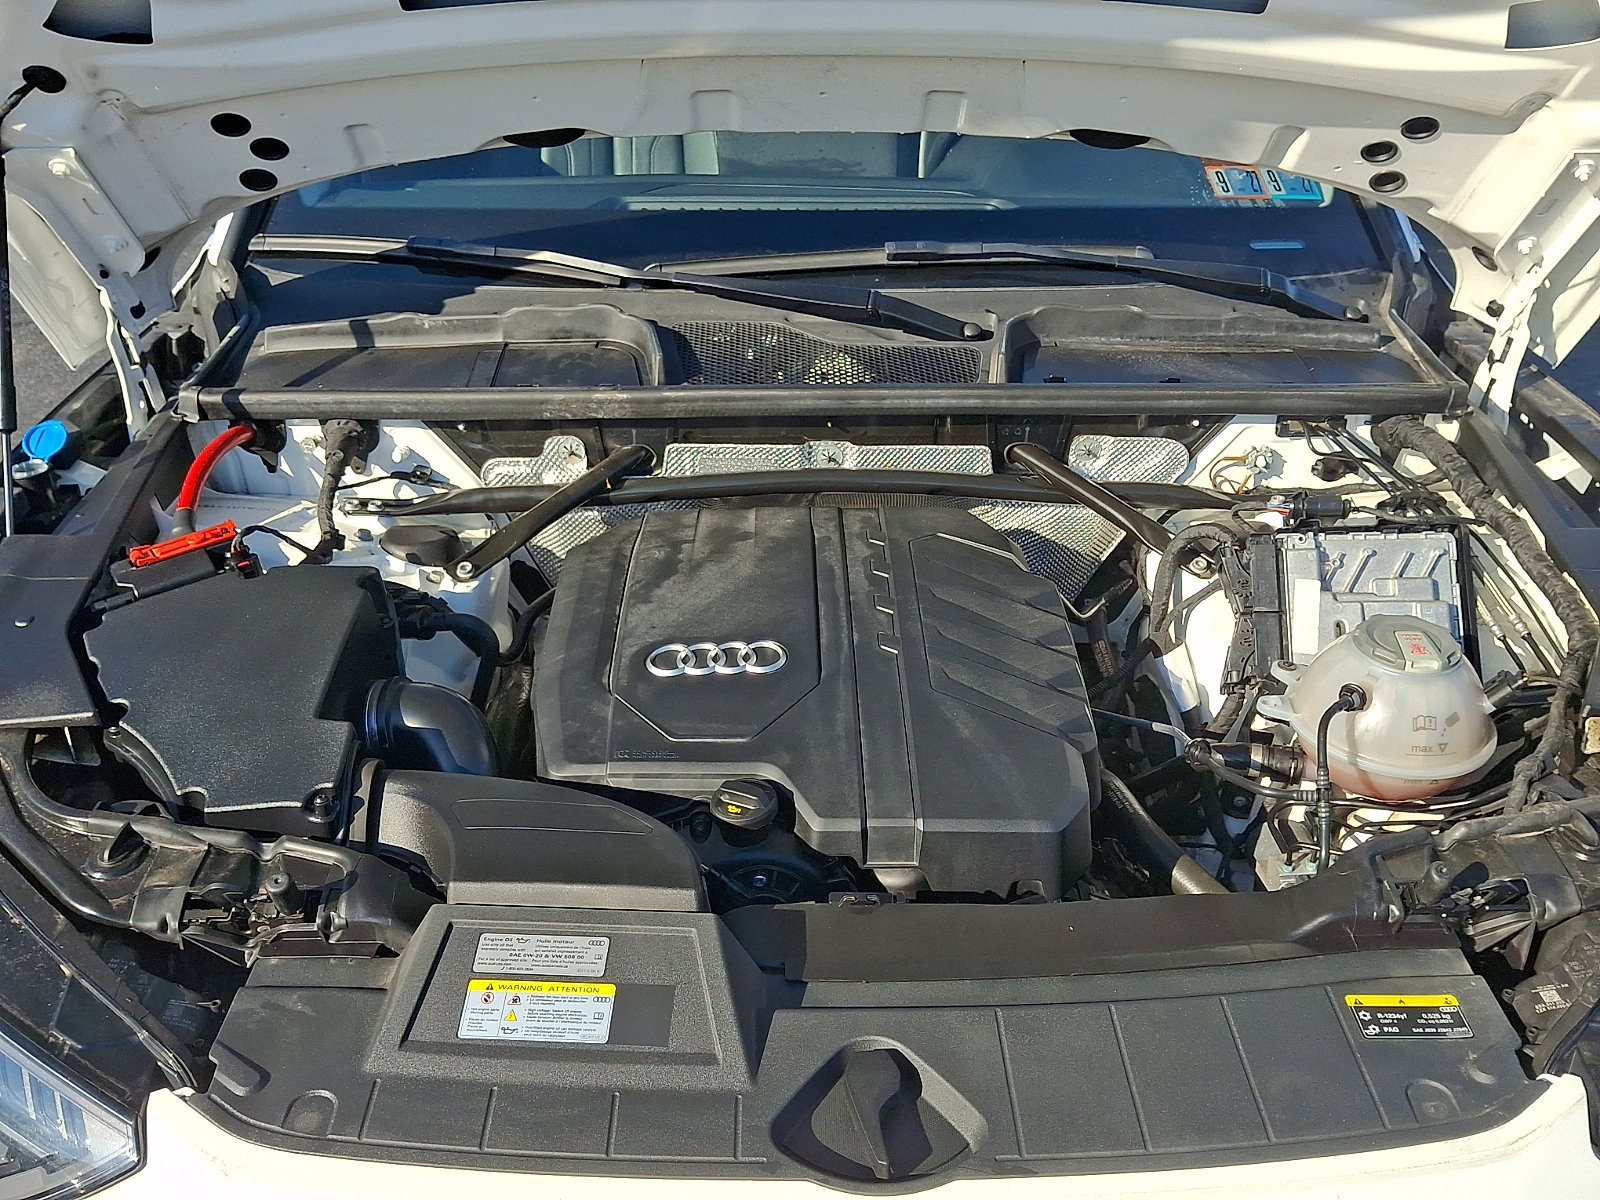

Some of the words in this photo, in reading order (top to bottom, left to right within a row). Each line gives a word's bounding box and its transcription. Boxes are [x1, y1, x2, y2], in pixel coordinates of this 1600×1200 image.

[1215, 170, 1231, 193] 9
[1266, 169, 1283, 192] 9
[1411, 744, 1433, 753] max
[548, 985, 600, 993] ATTENTION
